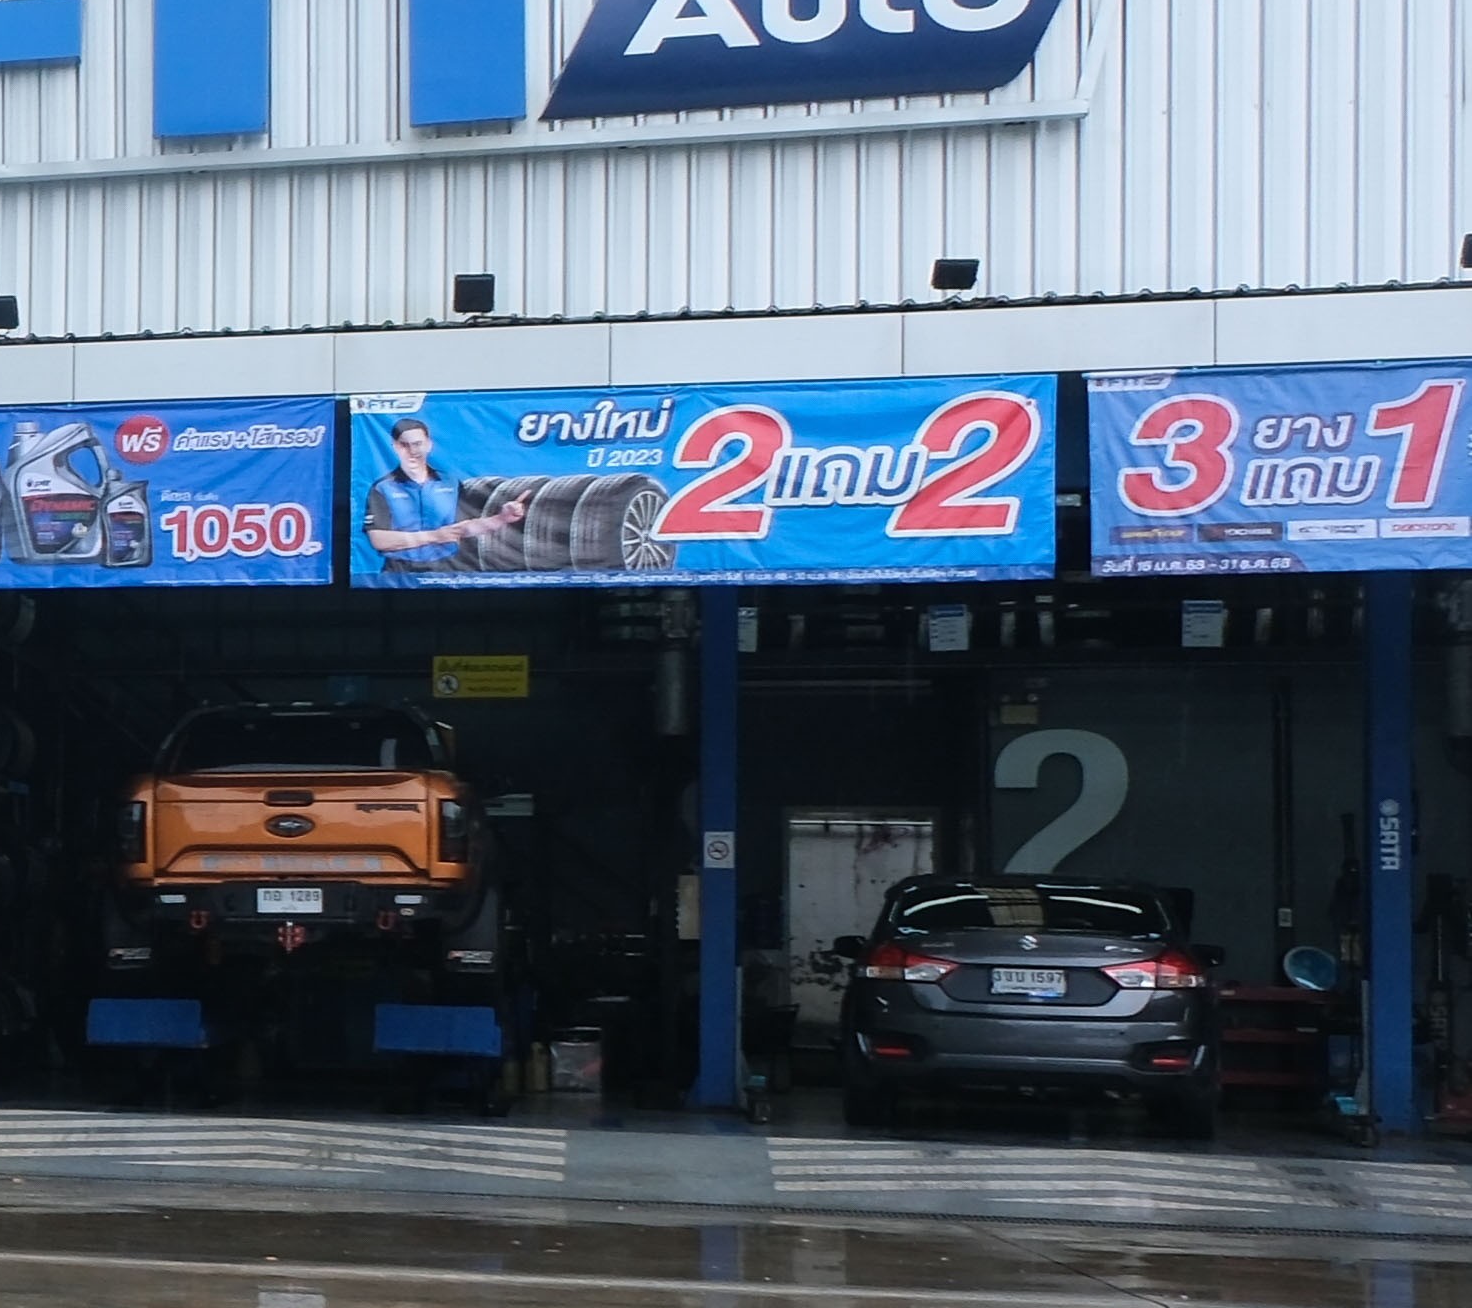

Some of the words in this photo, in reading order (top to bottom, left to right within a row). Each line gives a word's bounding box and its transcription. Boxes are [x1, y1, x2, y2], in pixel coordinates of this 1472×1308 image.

[122, 425, 163, 453] ฟรี
[518, 398, 674, 442] ยางใหม่
[767, 448, 926, 502] แถม
[587, 448, 604, 468] ปี
[606, 448, 663, 467] 2023
[1120, 394, 1238, 515] 3
[1254, 414, 1351, 449] ยาง
[1367, 380, 1463, 508] 1
[1242, 456, 1378, 505] แถม
[994, 729, 1130, 876] 2
[1380, 817, 1401, 871] SATA
[1031, 971, 1063, 984] 1597
